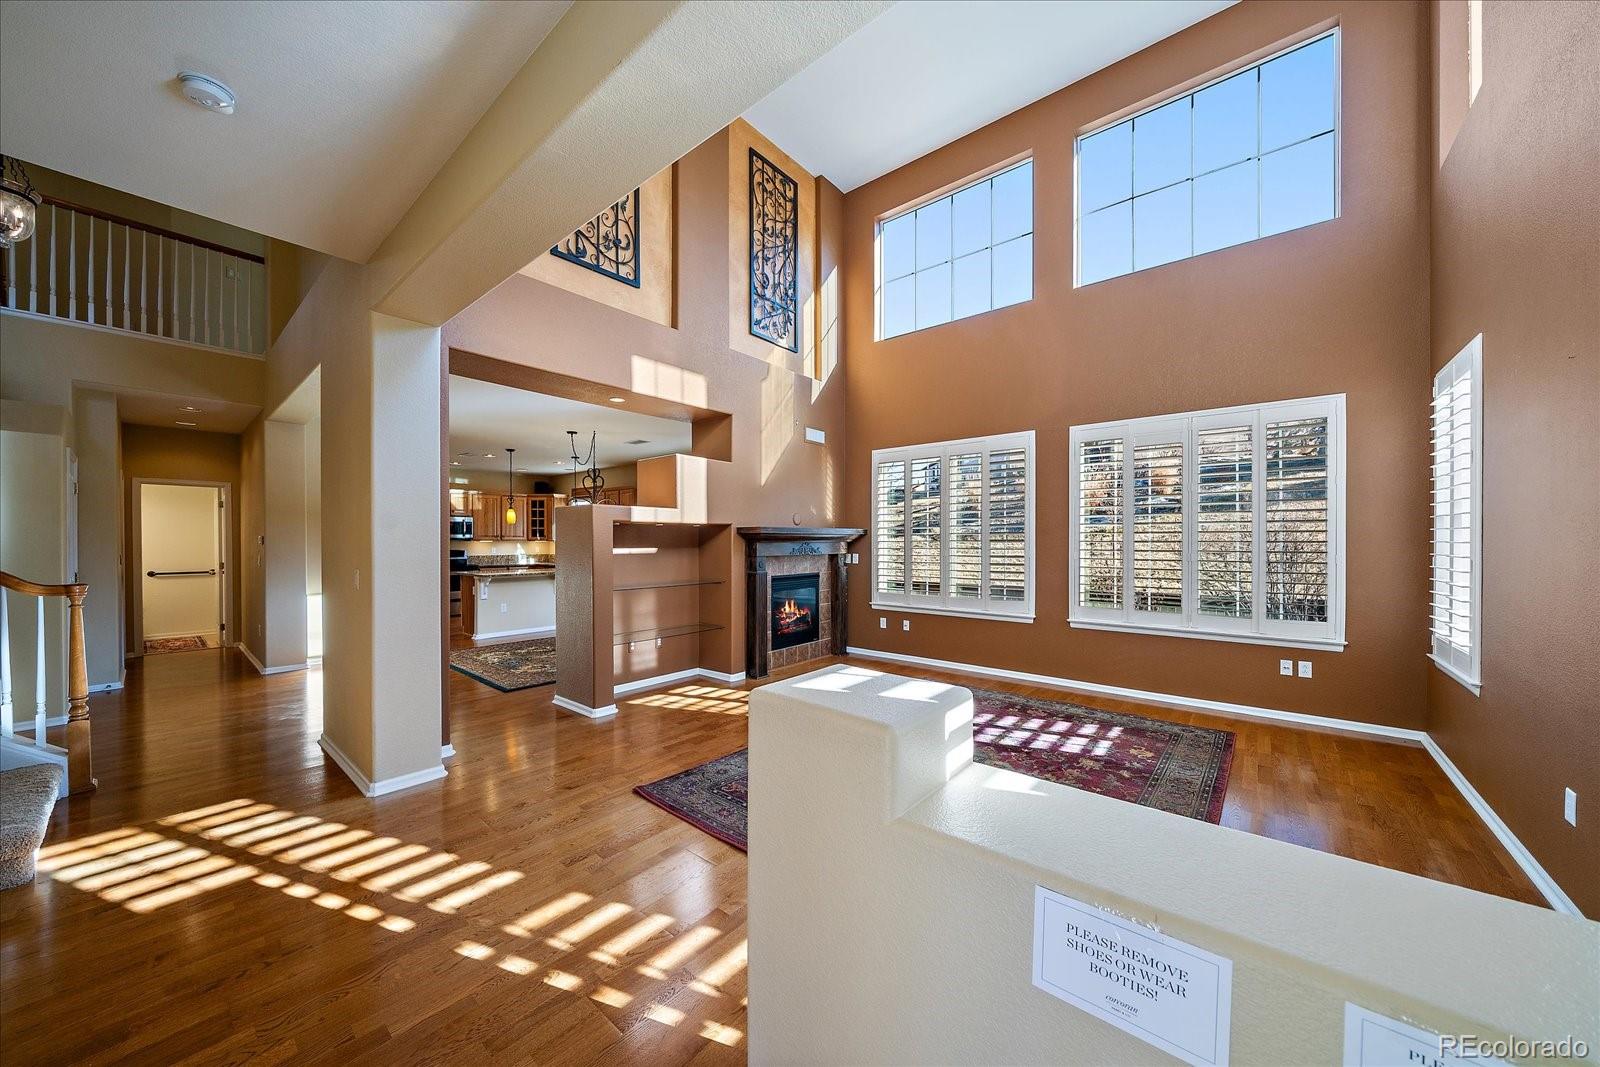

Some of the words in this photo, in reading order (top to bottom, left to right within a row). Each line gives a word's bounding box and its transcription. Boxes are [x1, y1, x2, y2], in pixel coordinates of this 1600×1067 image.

[1066, 922, 1118, 953] PLEASE
[1121, 945, 1189, 983] REMOVE
[1066, 938, 1113, 965] SHOES
[1115, 961, 1137, 976] OR
[1139, 968, 1187, 998] WEAR
[1089, 962, 1159, 1002] BOOTIES!
